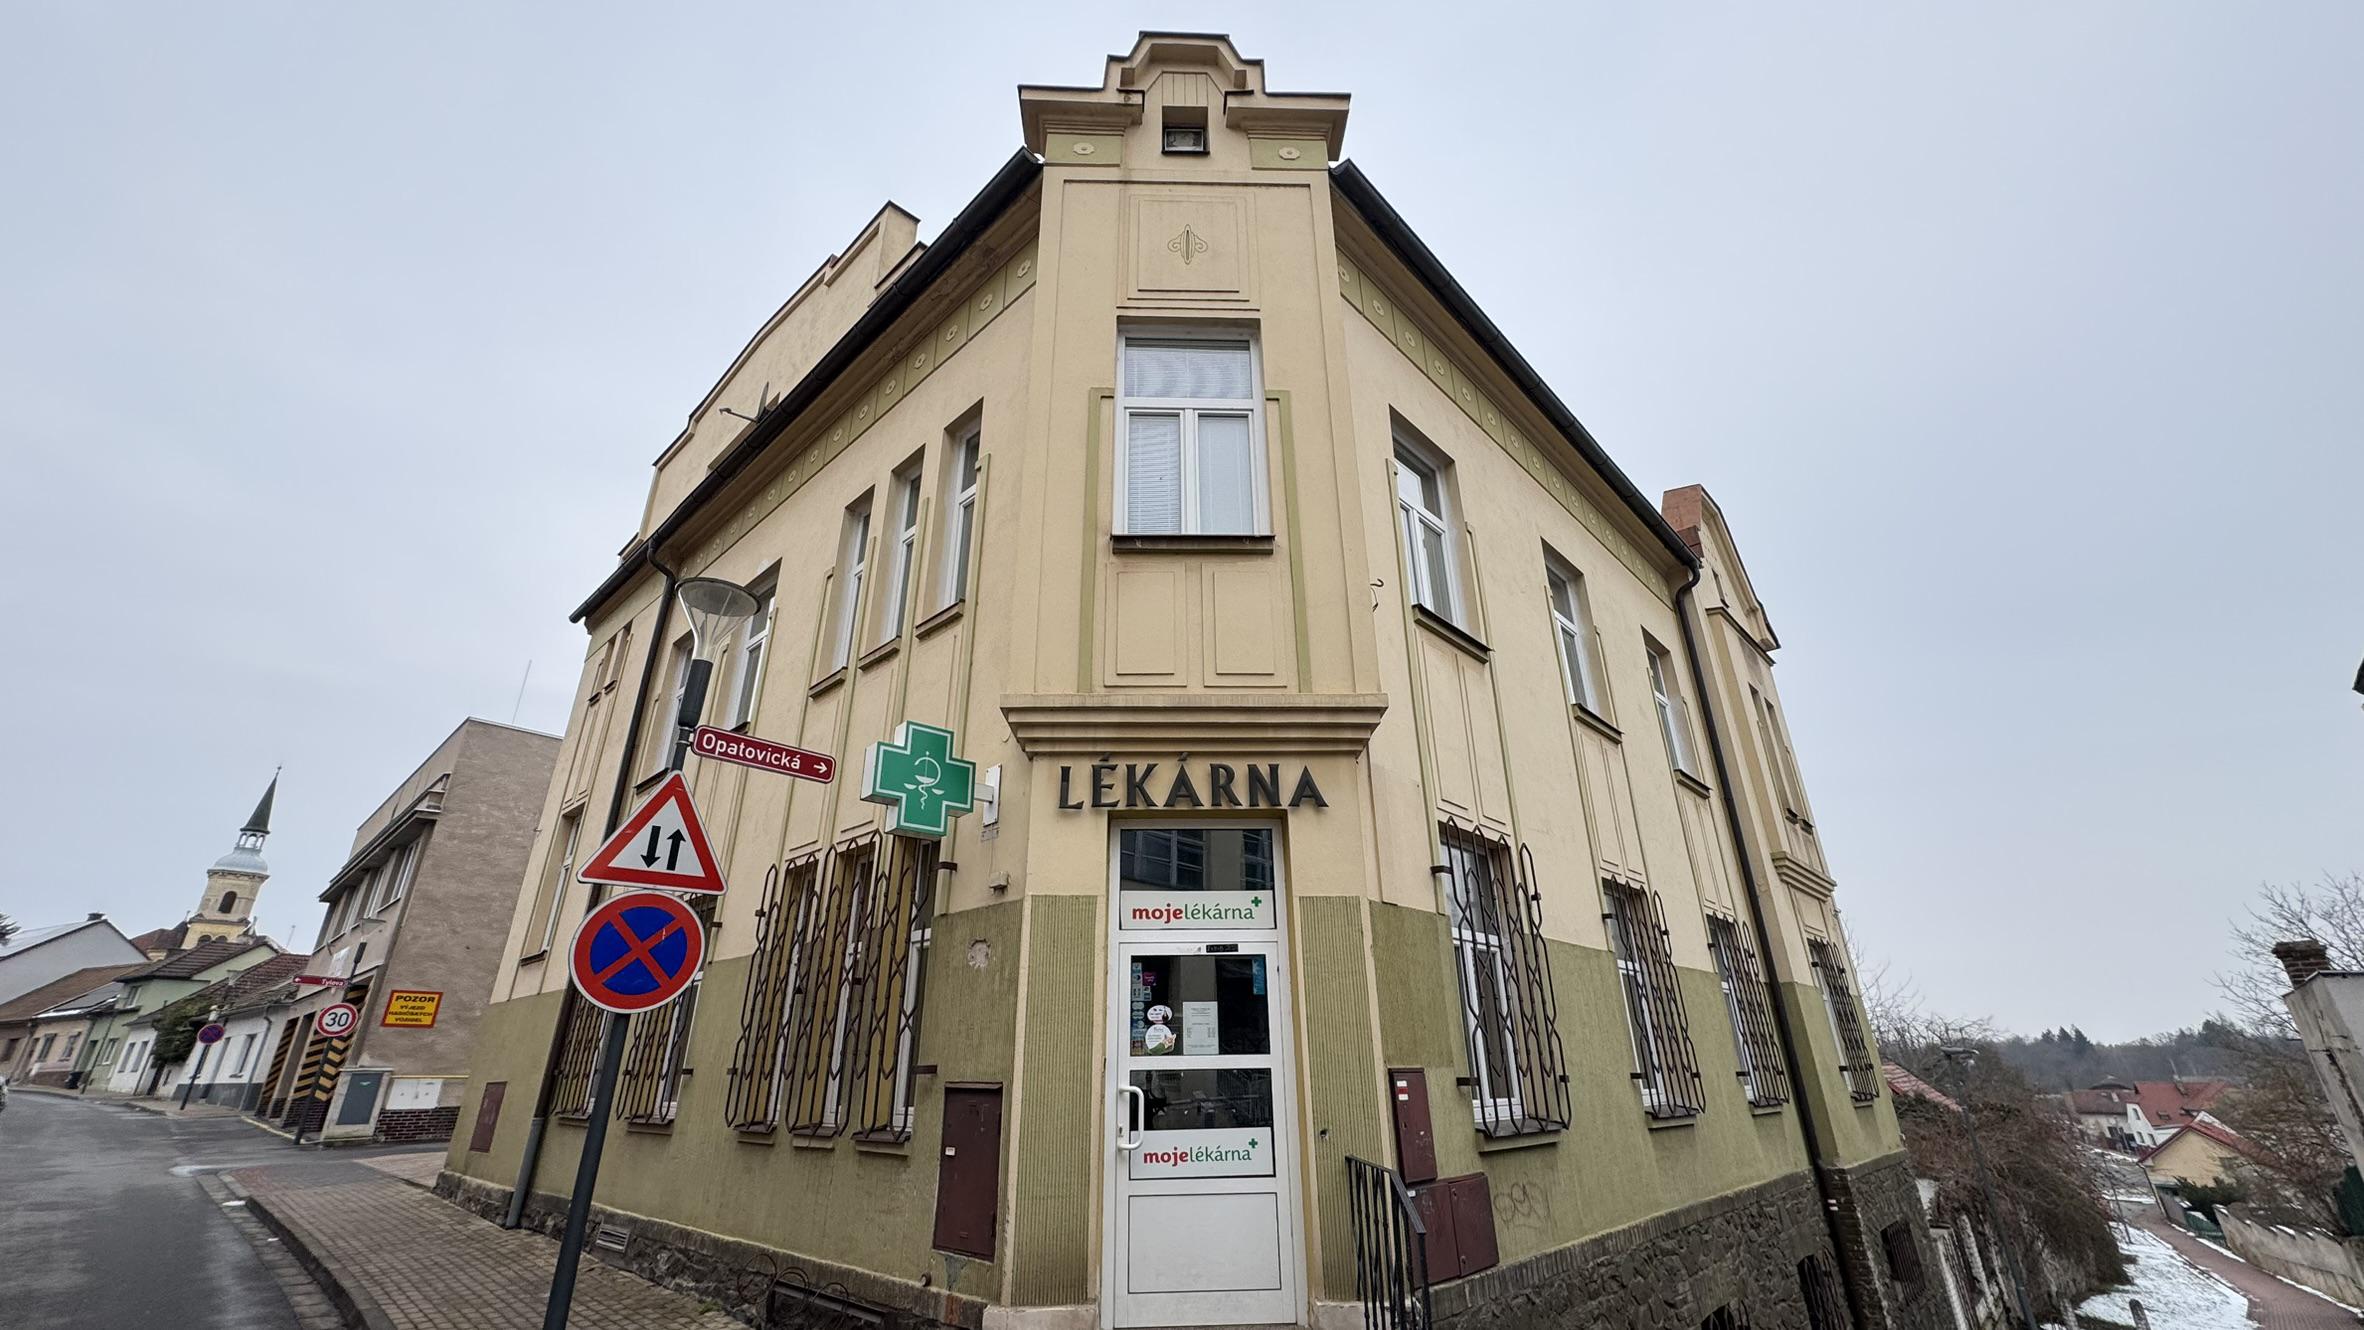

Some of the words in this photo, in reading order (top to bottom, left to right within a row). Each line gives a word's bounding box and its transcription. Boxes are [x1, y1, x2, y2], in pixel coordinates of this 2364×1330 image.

[702, 733, 801, 769] Opatovická
[1058, 752, 1329, 809] LÉKÁRNA
[321, 978, 344, 987] Tylova
[395, 995, 436, 1003] POZOR
[325, 1011, 350, 1027] 30
